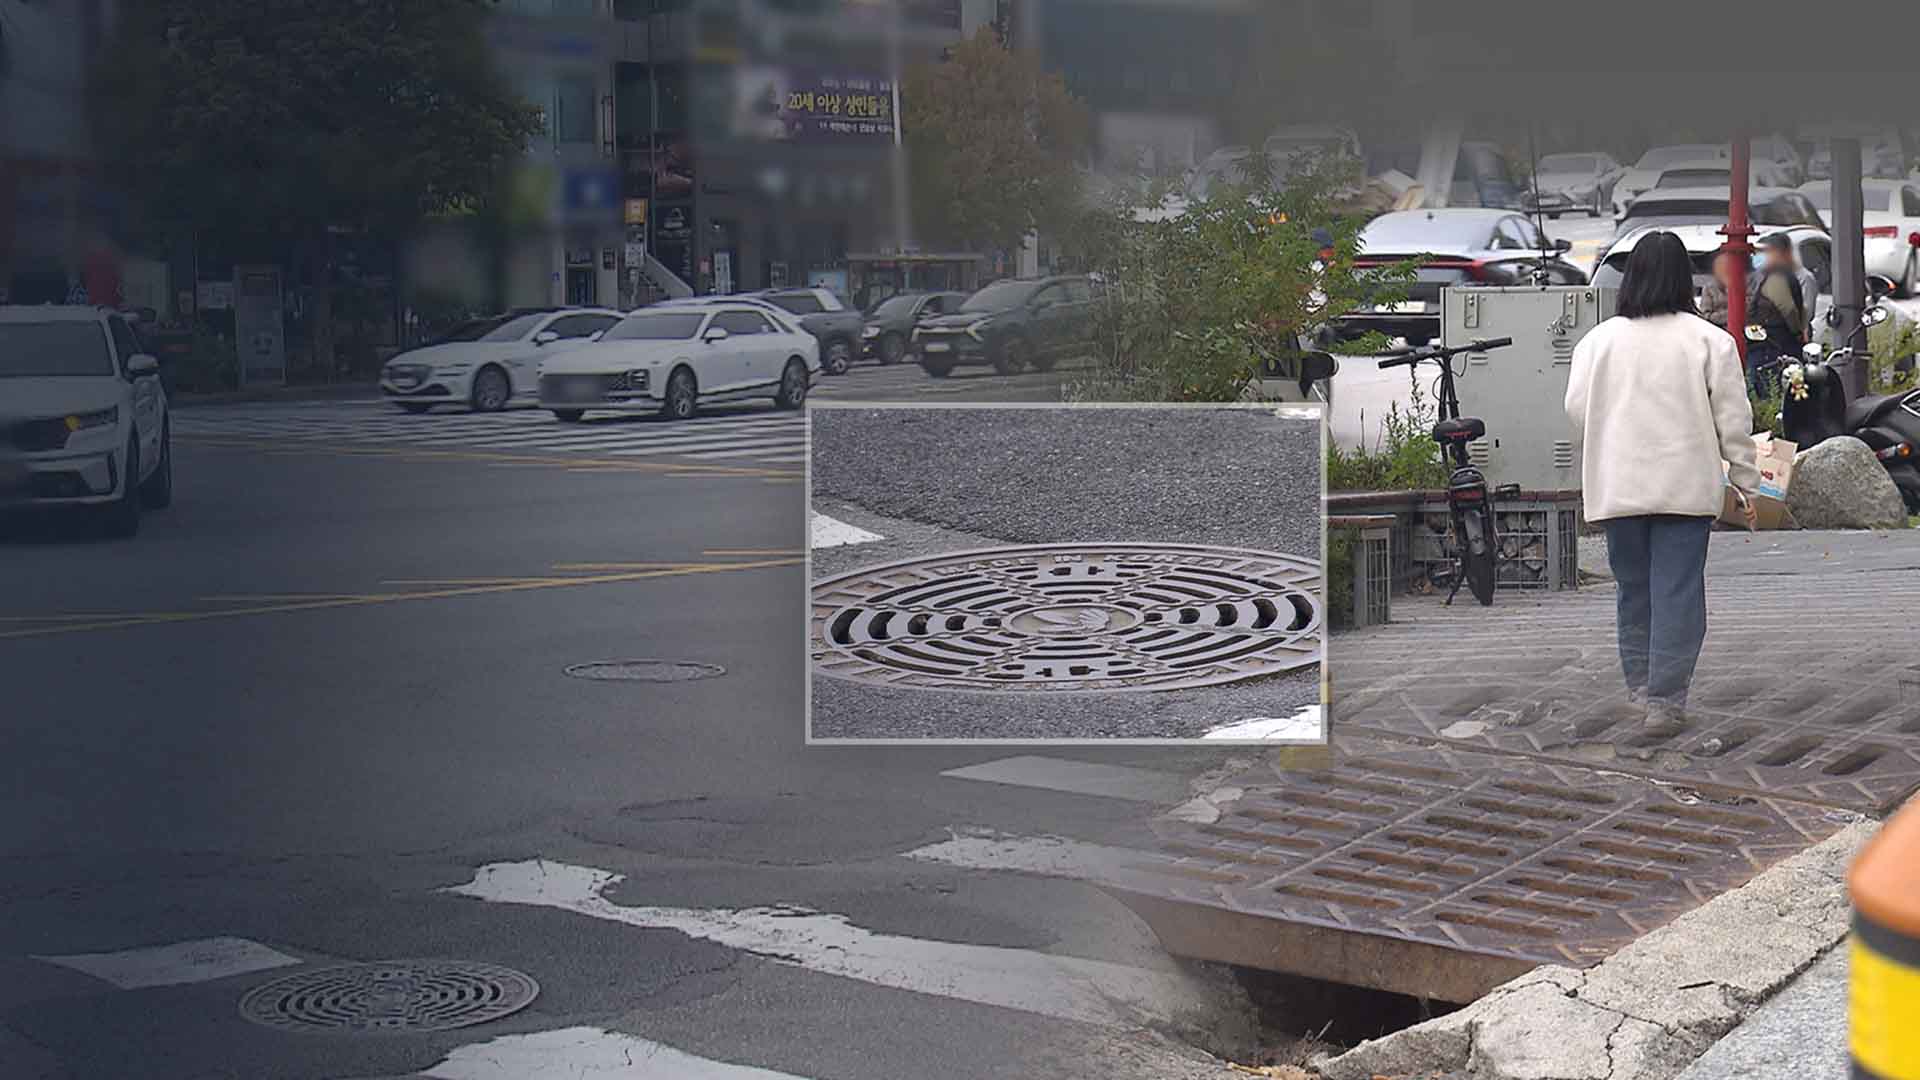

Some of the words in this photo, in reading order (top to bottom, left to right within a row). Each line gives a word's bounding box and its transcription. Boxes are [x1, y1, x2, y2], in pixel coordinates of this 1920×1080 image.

[788, 92, 814, 112] 20세
[817, 94, 842, 114] 이상
[934, 558, 1038, 575] MADE
[1054, 554, 1082, 563] IN
[1104, 554, 1224, 568] KOREA
